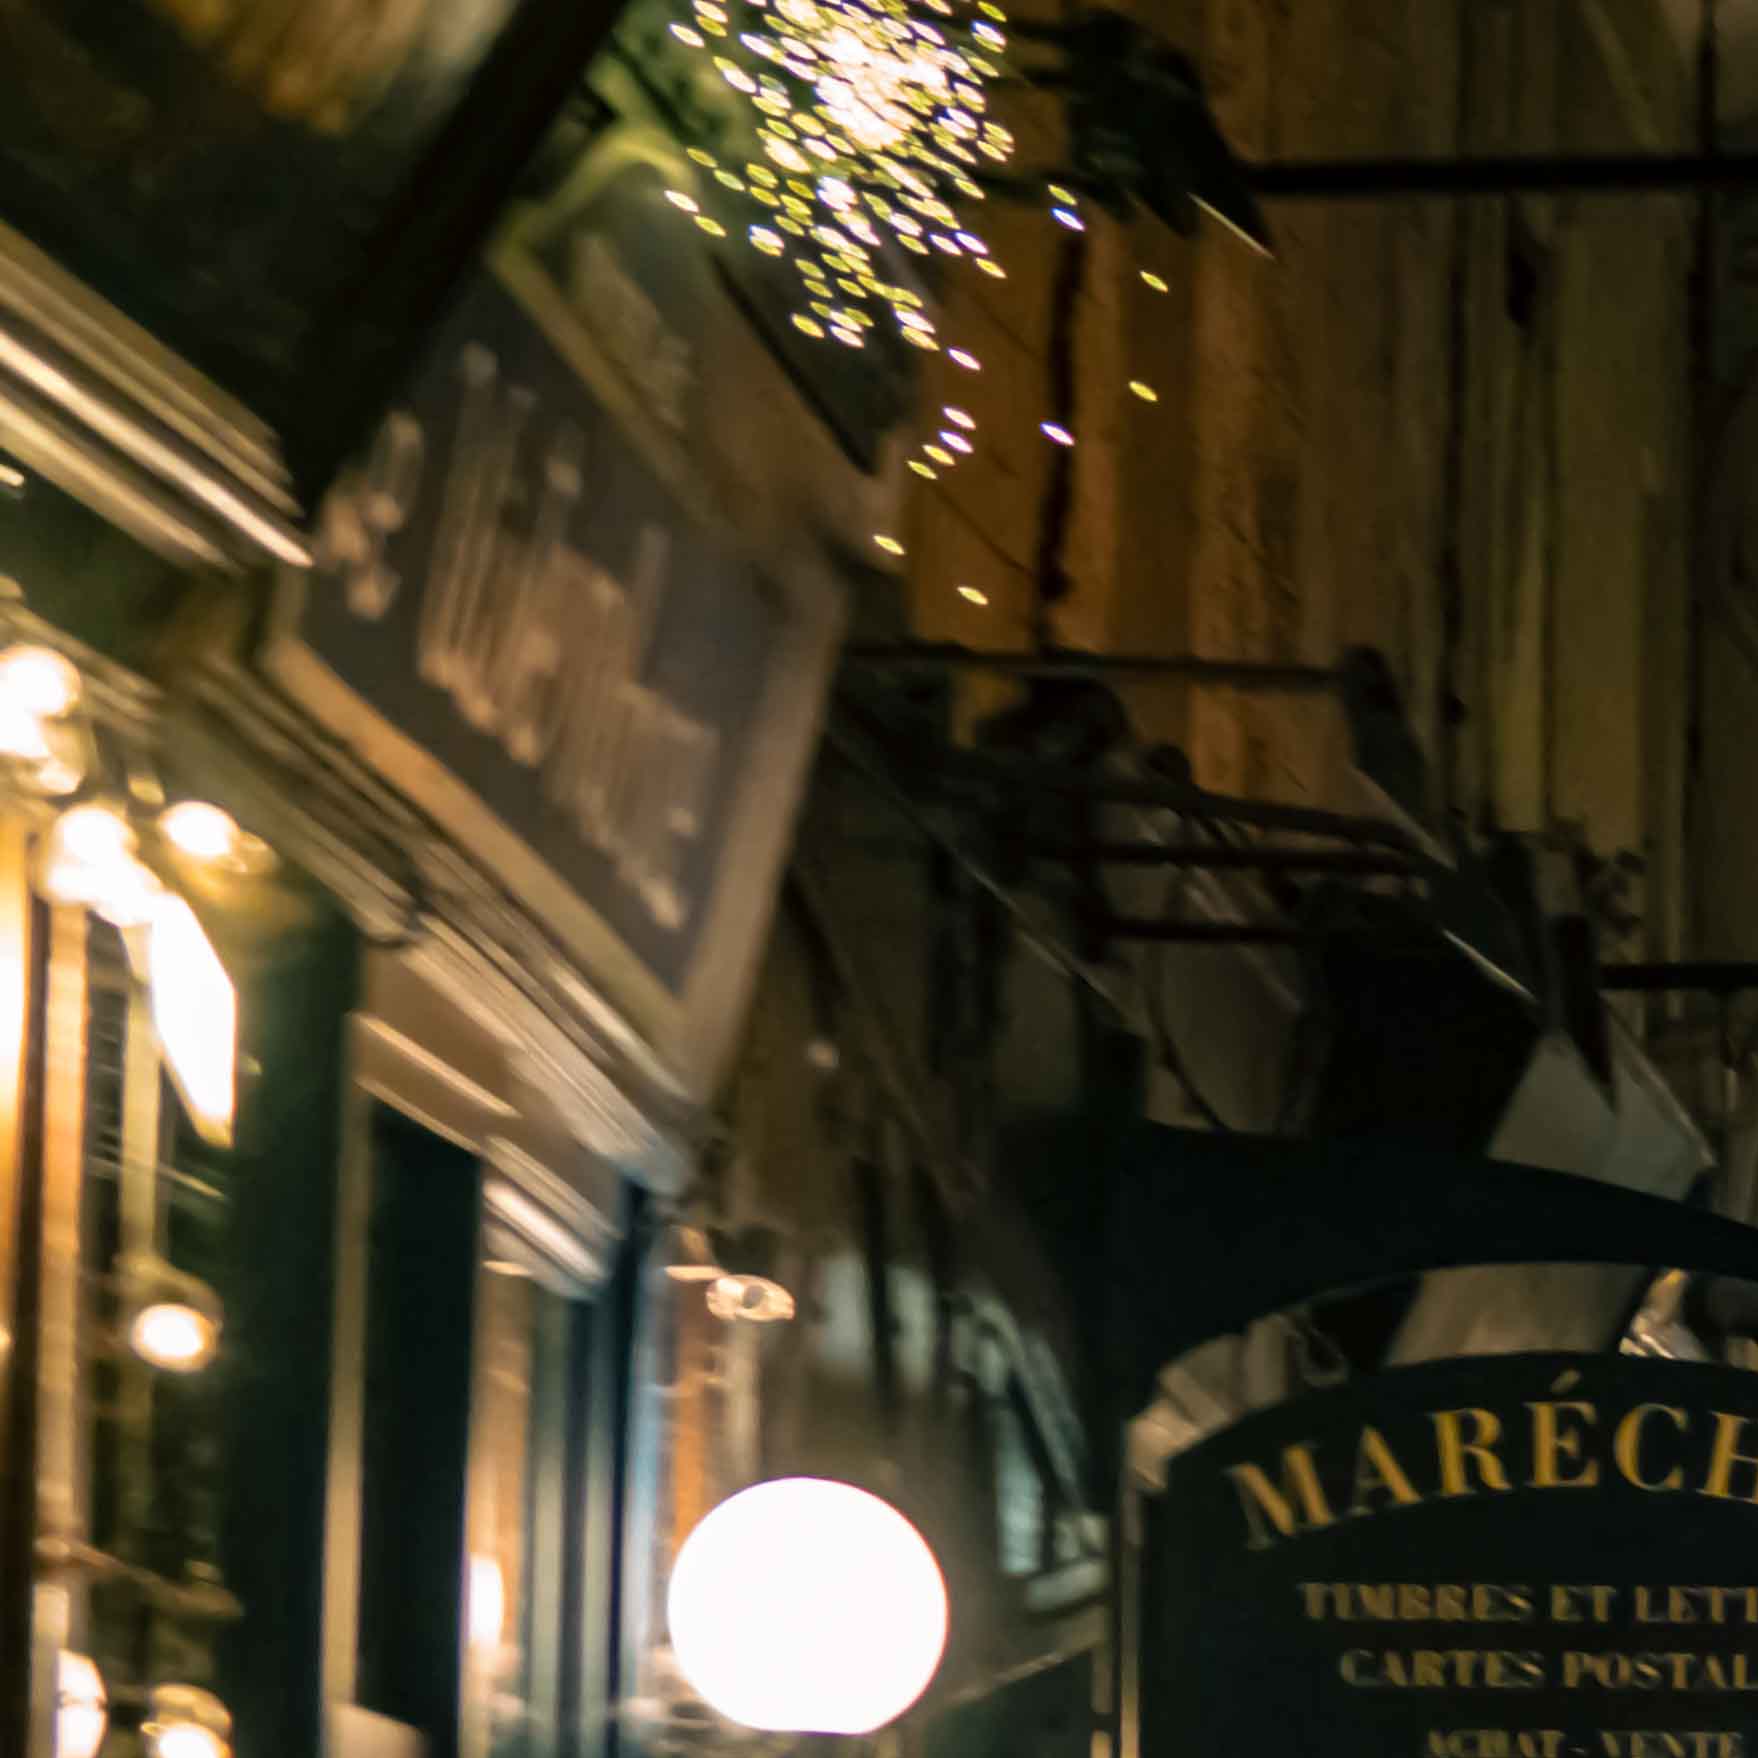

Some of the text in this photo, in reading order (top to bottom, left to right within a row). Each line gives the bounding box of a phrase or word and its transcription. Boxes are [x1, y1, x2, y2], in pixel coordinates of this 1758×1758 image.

[1299, 1582, 1534, 1622] TIMBRES
[1550, 1585, 1617, 1623] ET
[1339, 1649, 1545, 1688] CARTES
